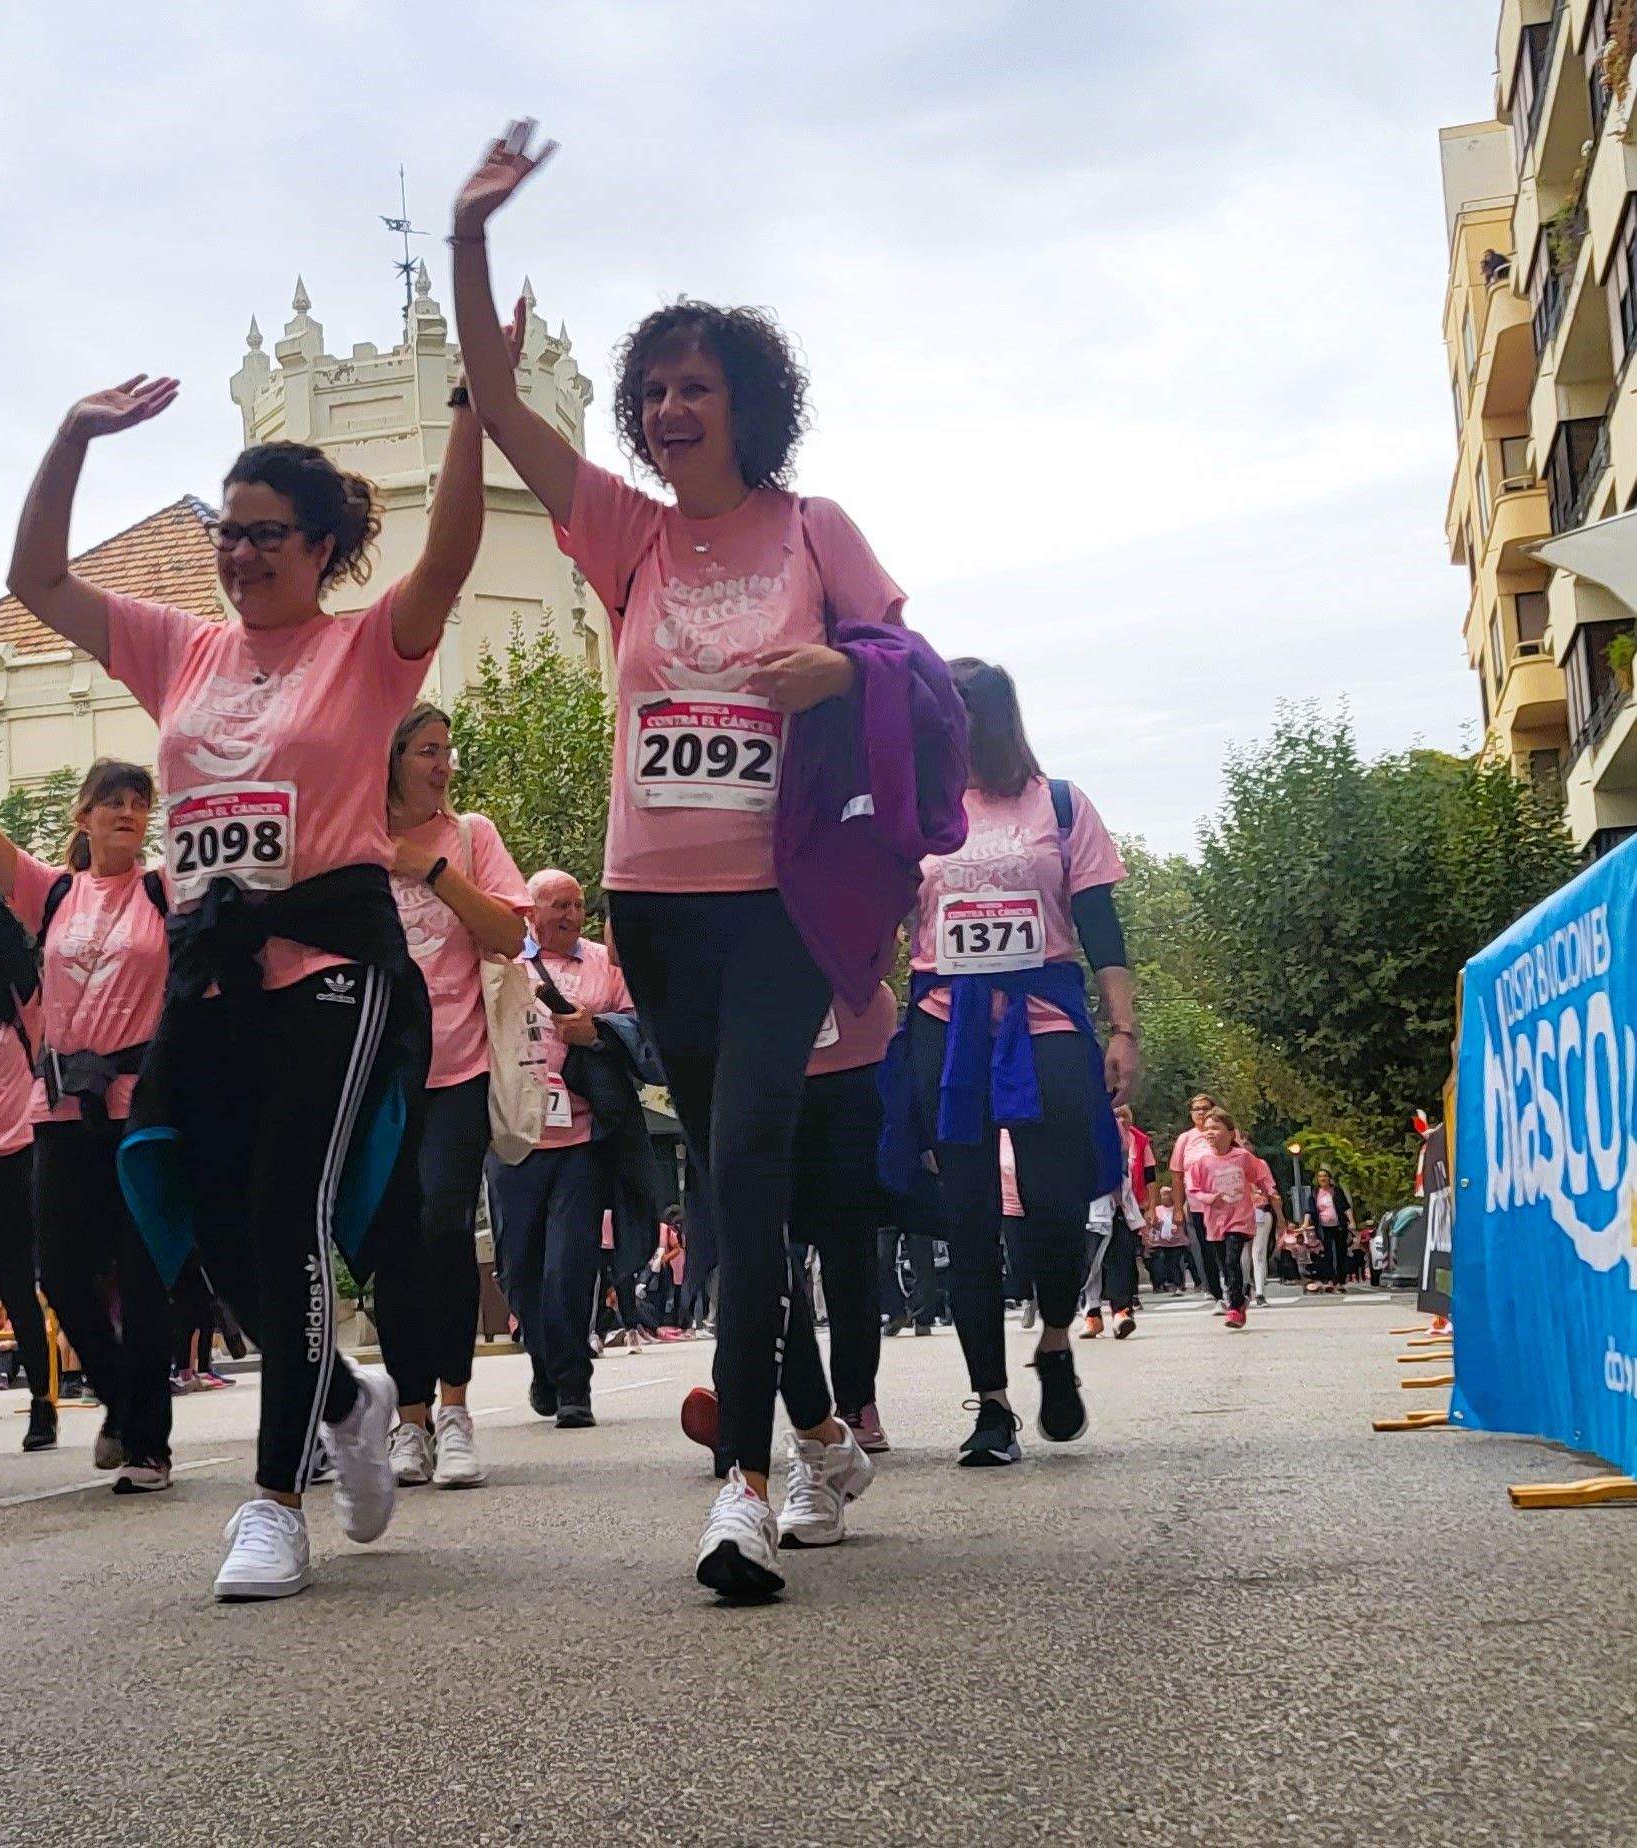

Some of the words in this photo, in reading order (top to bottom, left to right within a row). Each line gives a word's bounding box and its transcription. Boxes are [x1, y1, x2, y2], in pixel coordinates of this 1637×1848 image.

[640, 732, 774, 784] 2092
[174, 820, 283, 875] 2098
[947, 920, 1034, 954] 1371
[304, 1283, 323, 1363] adidas
